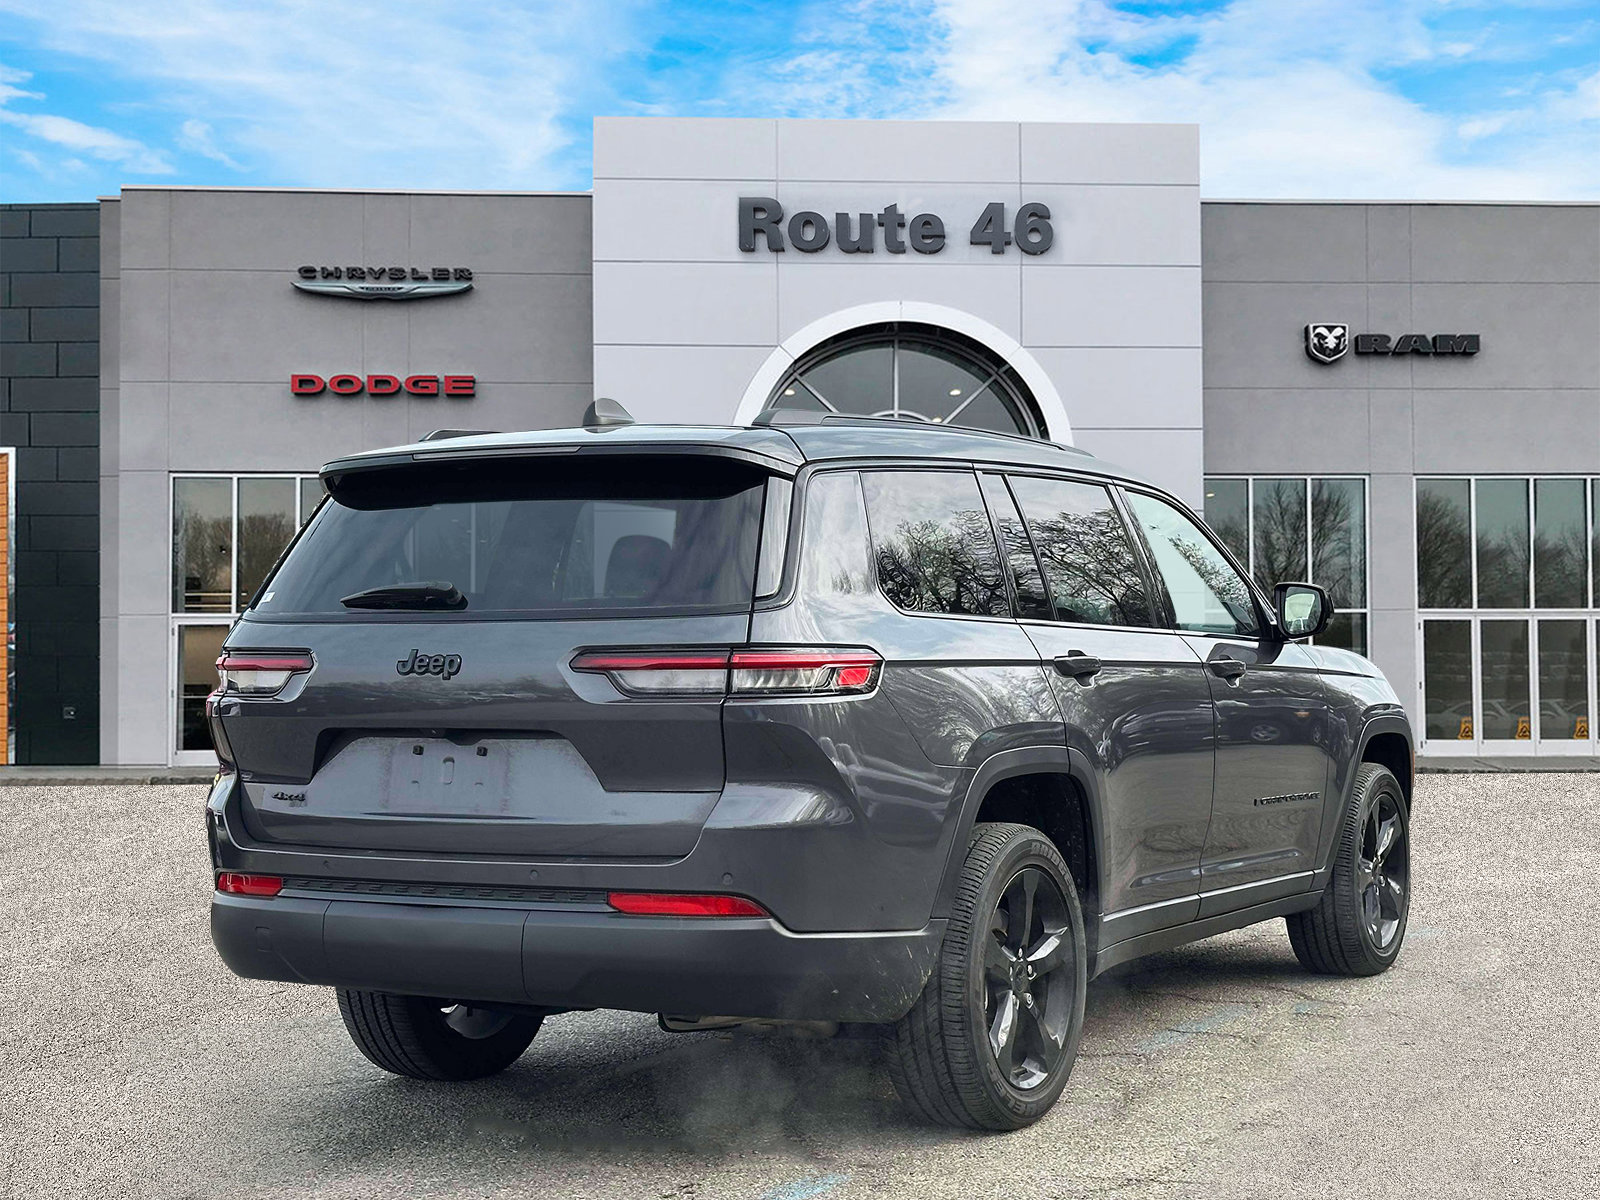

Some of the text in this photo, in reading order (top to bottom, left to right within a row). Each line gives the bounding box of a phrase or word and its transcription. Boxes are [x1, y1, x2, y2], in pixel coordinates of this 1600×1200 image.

[738, 197, 1055, 256] Route 46
[297, 265, 474, 281] CHRYSLER
[1354, 333, 1481, 355] RAM
[291, 374, 476, 397] DODGE
[396, 648, 463, 681] Jeep
